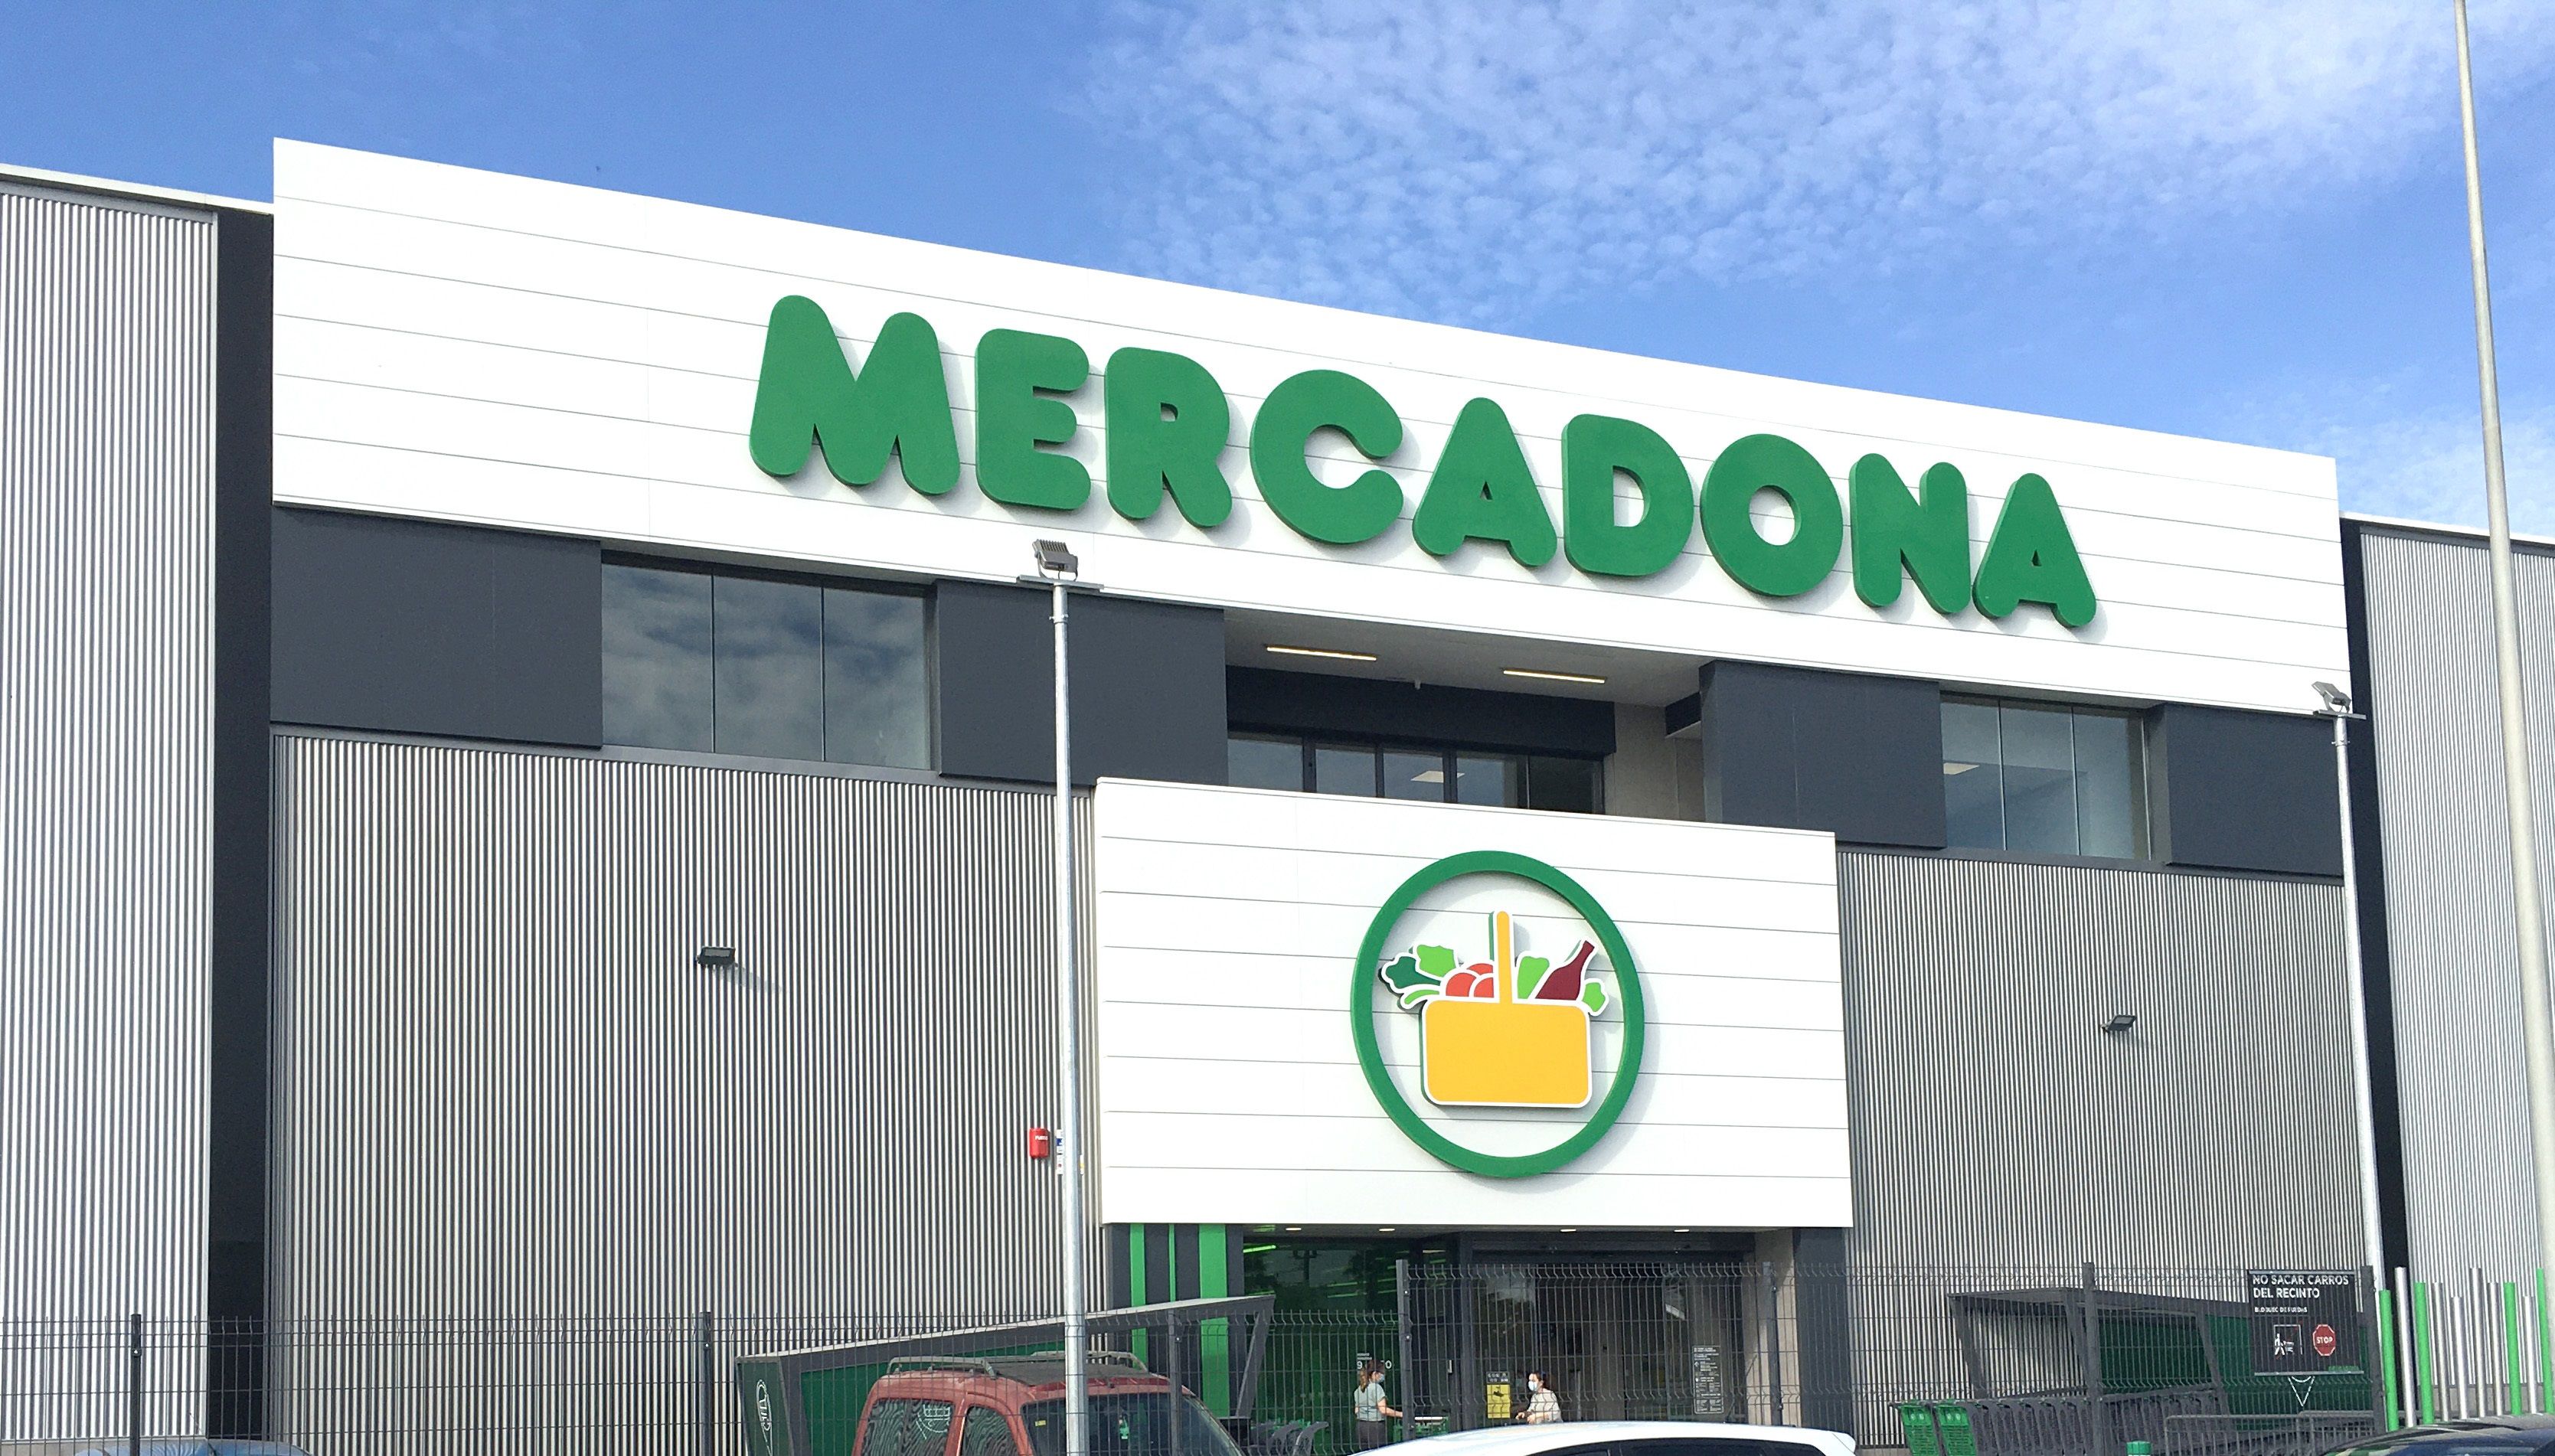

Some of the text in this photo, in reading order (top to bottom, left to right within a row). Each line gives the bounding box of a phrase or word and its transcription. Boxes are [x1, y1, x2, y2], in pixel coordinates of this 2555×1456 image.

[747, 295, 2097, 627] MERCADONA
[2253, 1275, 2349, 1285] NO SACAR CARROS
[2253, 1288, 2320, 1298] DEL RECINTO
[2316, 1336, 2333, 1344] STOP
